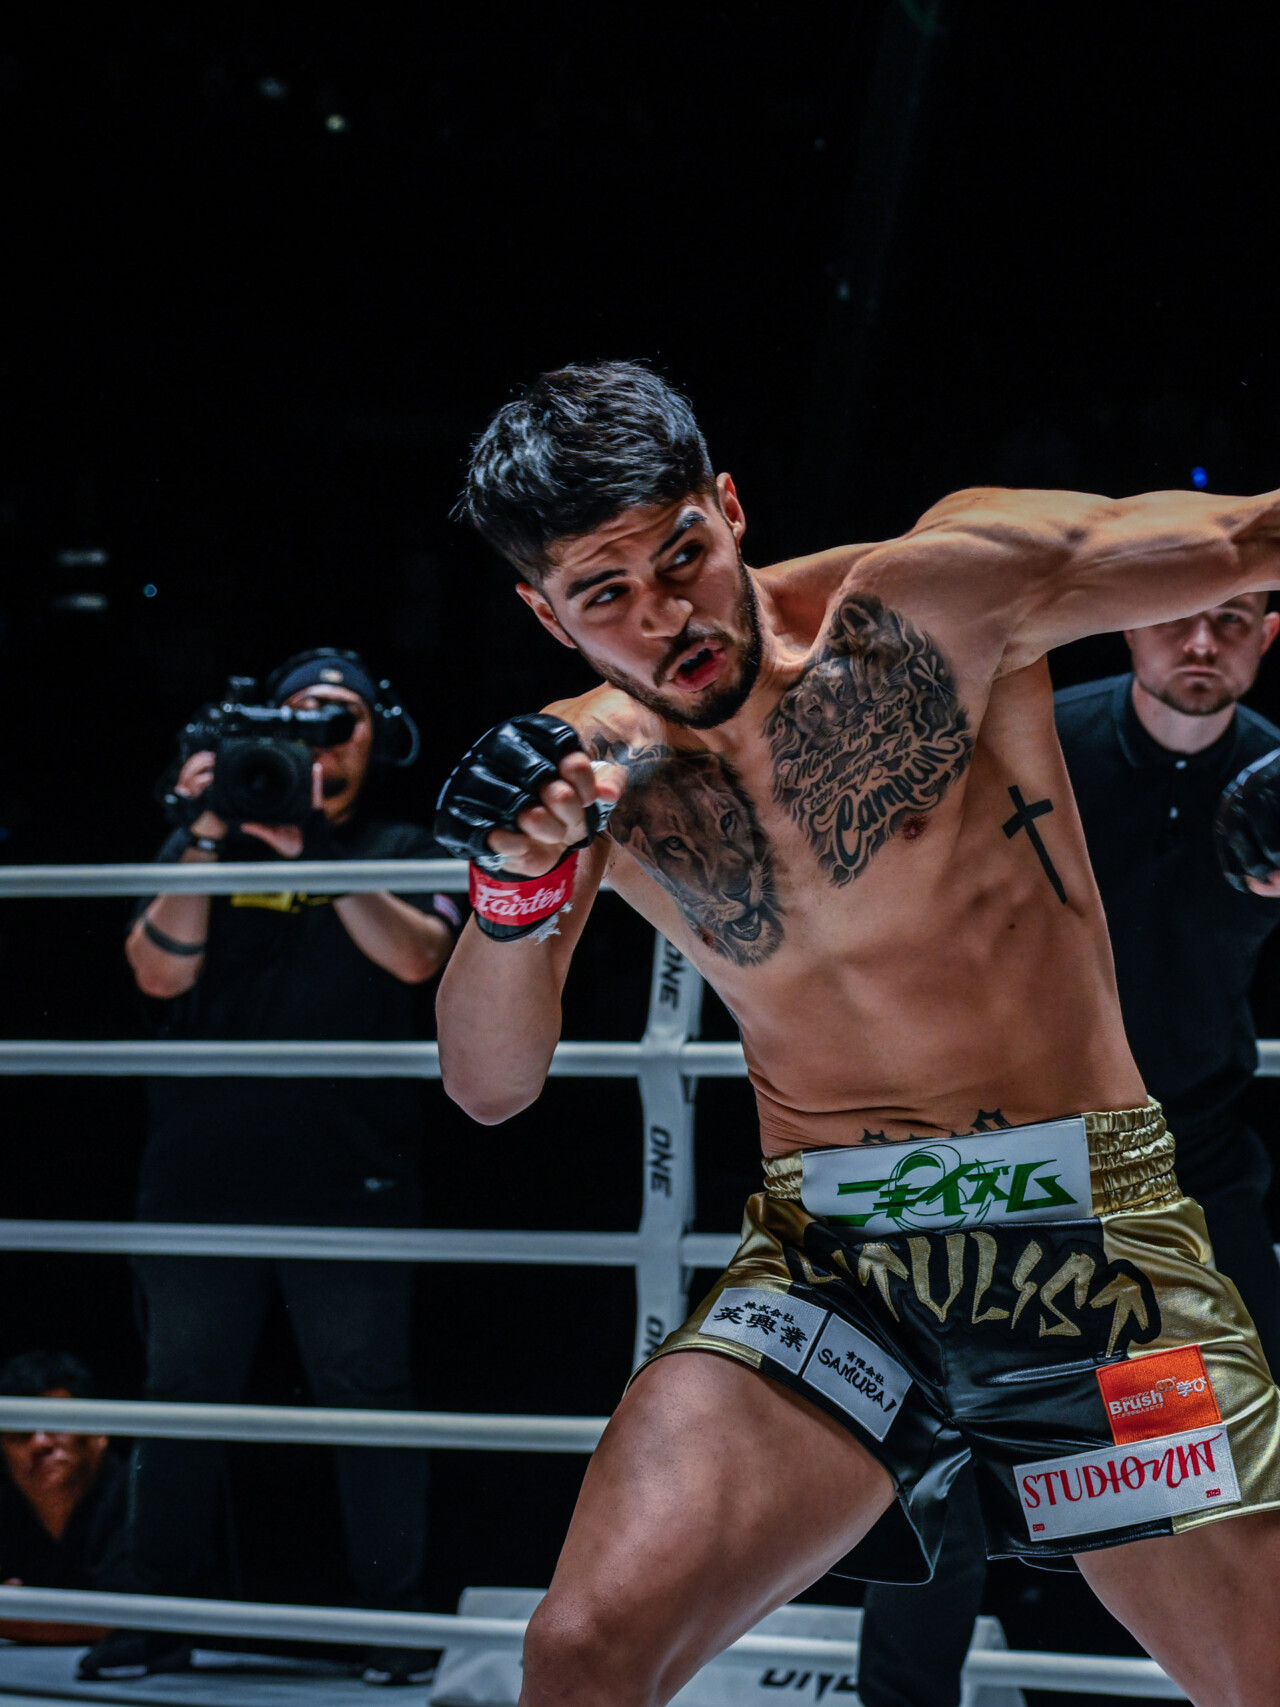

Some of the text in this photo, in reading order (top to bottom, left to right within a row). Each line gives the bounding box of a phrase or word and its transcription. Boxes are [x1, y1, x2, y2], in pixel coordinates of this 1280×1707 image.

[474, 880, 567, 917] Fairtex
[649, 1124, 674, 1198] ONE
[743, 1301, 795, 1325] 株式会社
[817, 1348, 897, 1413] SAMURAI
[845, 1351, 885, 1386] 有限会社
[1109, 1389, 1164, 1416] Brush
[1176, 1376, 1208, 1398] 学び
